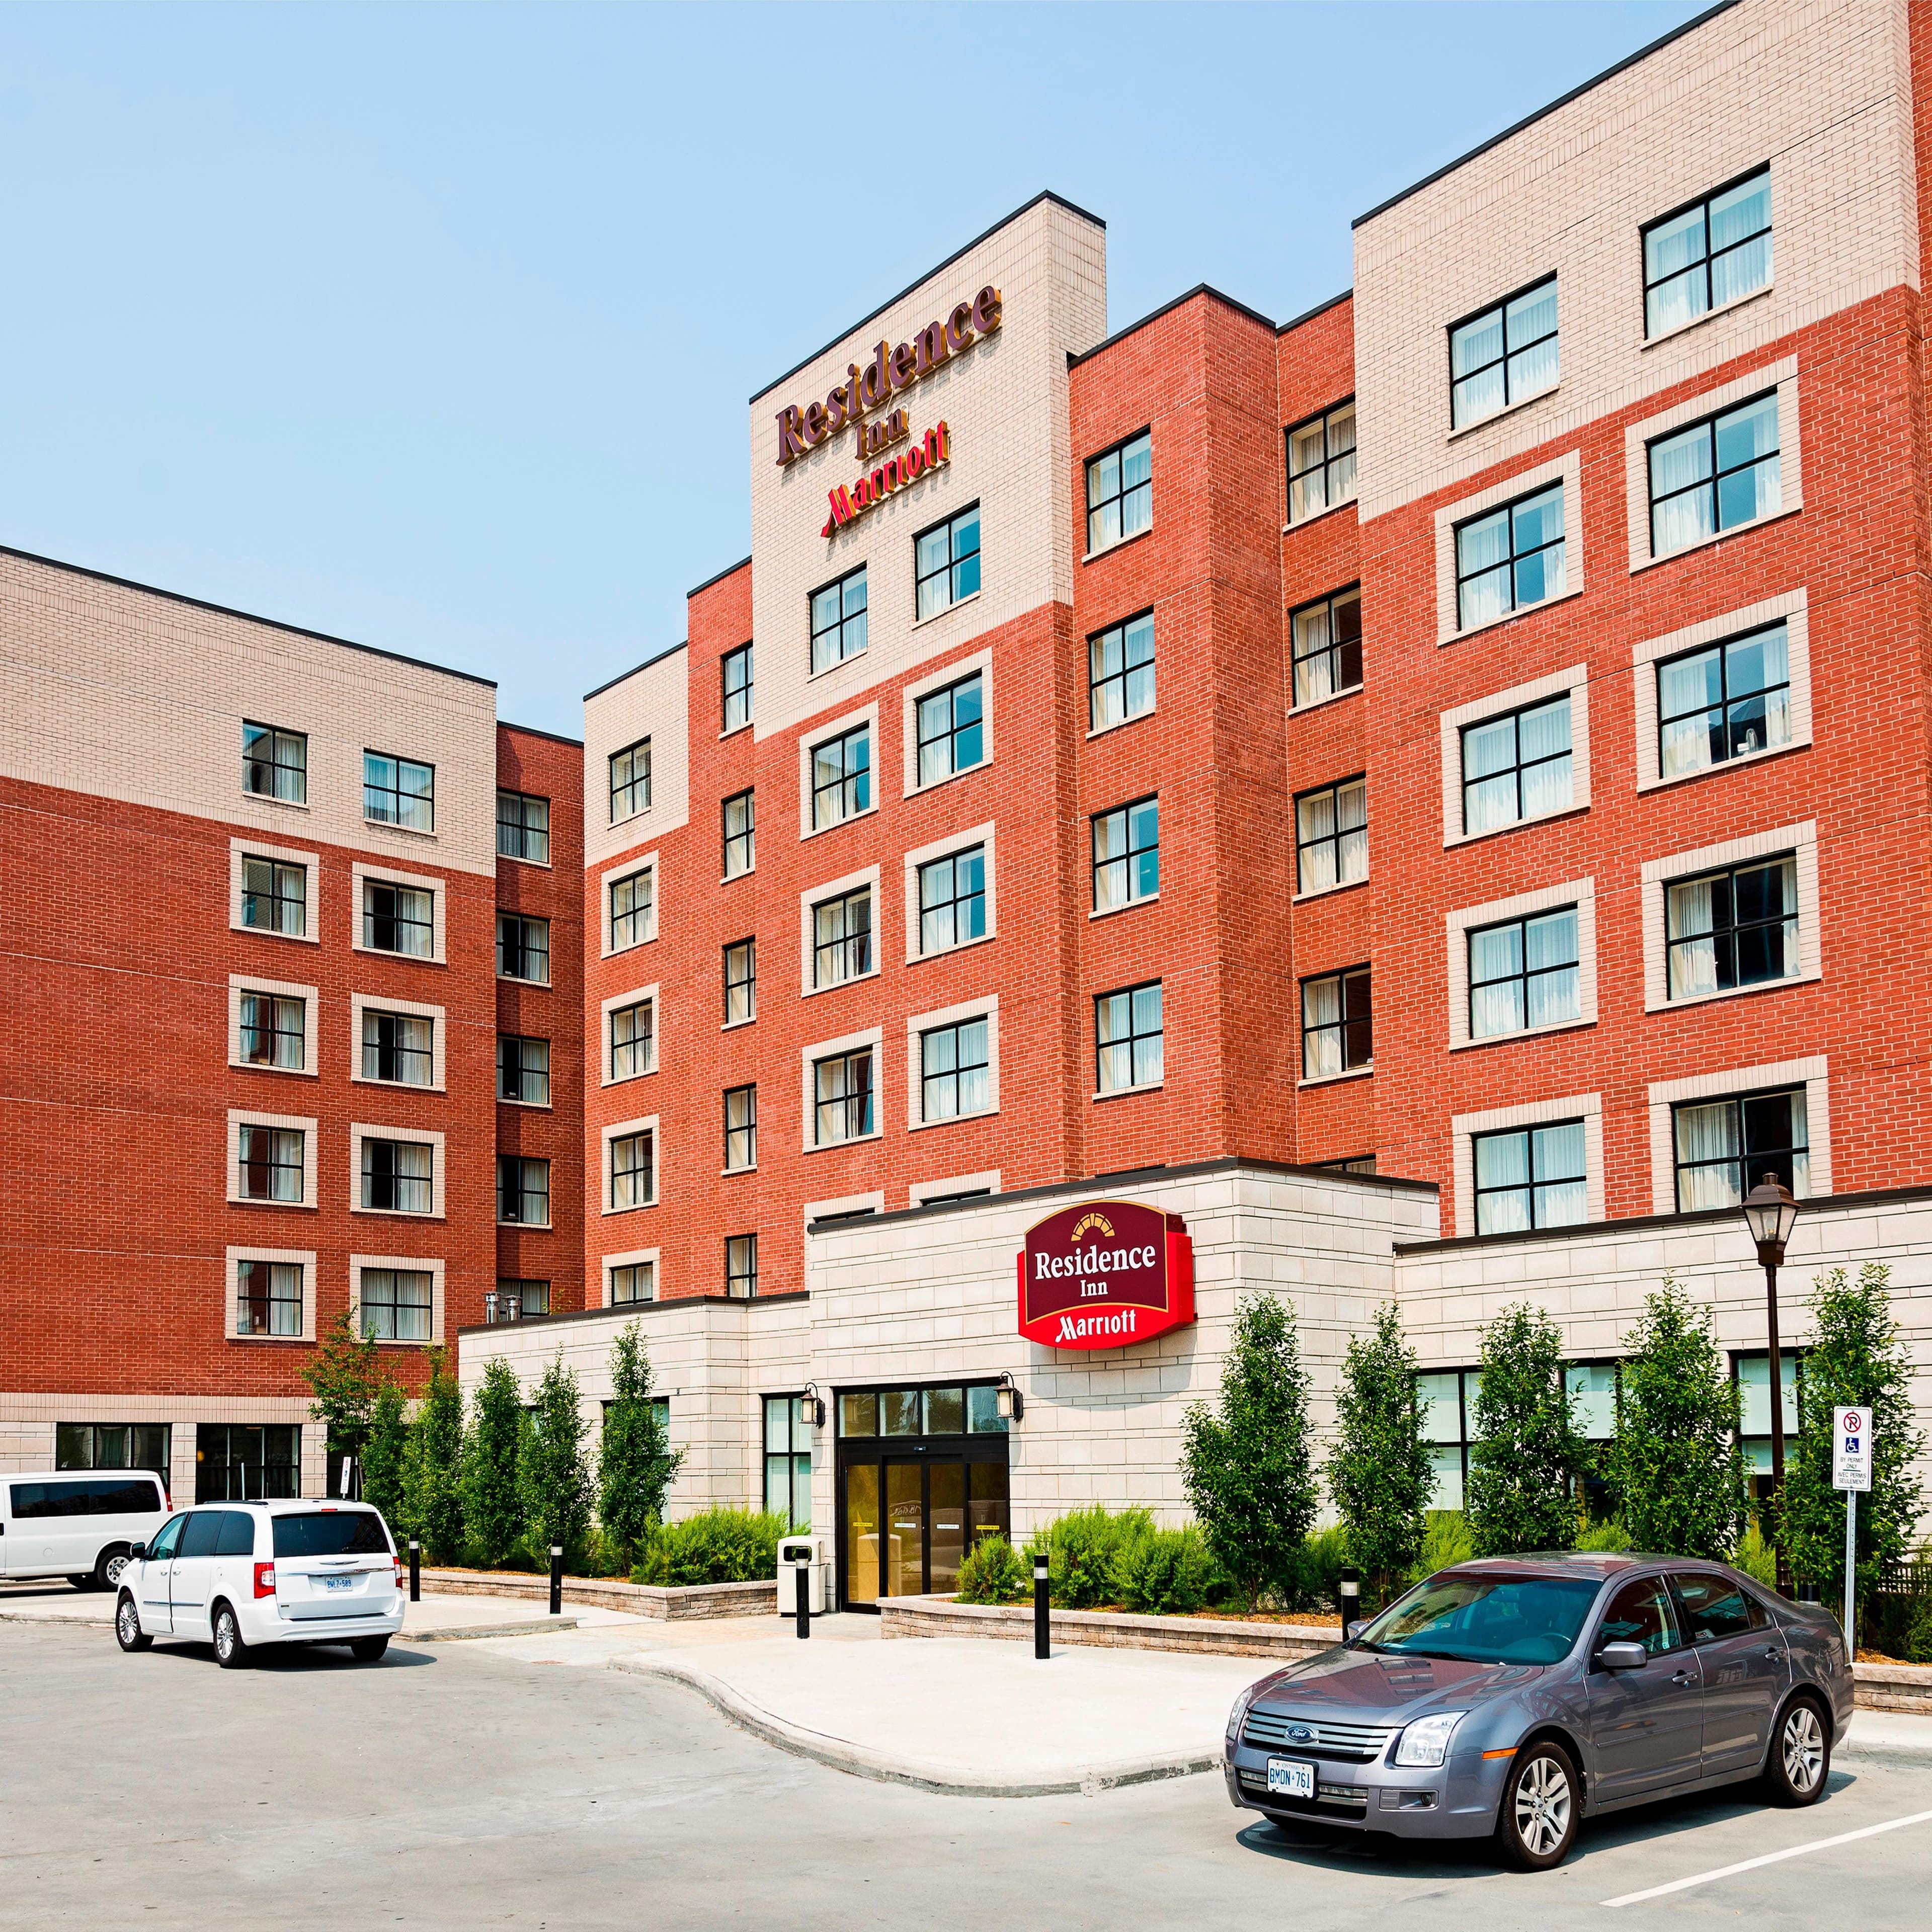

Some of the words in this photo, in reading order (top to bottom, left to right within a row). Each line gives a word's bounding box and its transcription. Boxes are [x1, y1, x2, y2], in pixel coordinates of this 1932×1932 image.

[775, 286, 1002, 466] Residence
[855, 408, 909, 460] Inn
[821, 420, 950, 538] Marriott
[1035, 1245, 1156, 1279] Residence
[1080, 1279, 1108, 1297] Inn
[1055, 1309, 1136, 1342] Marriott
[1291, 1729, 1307, 1737] Ford
